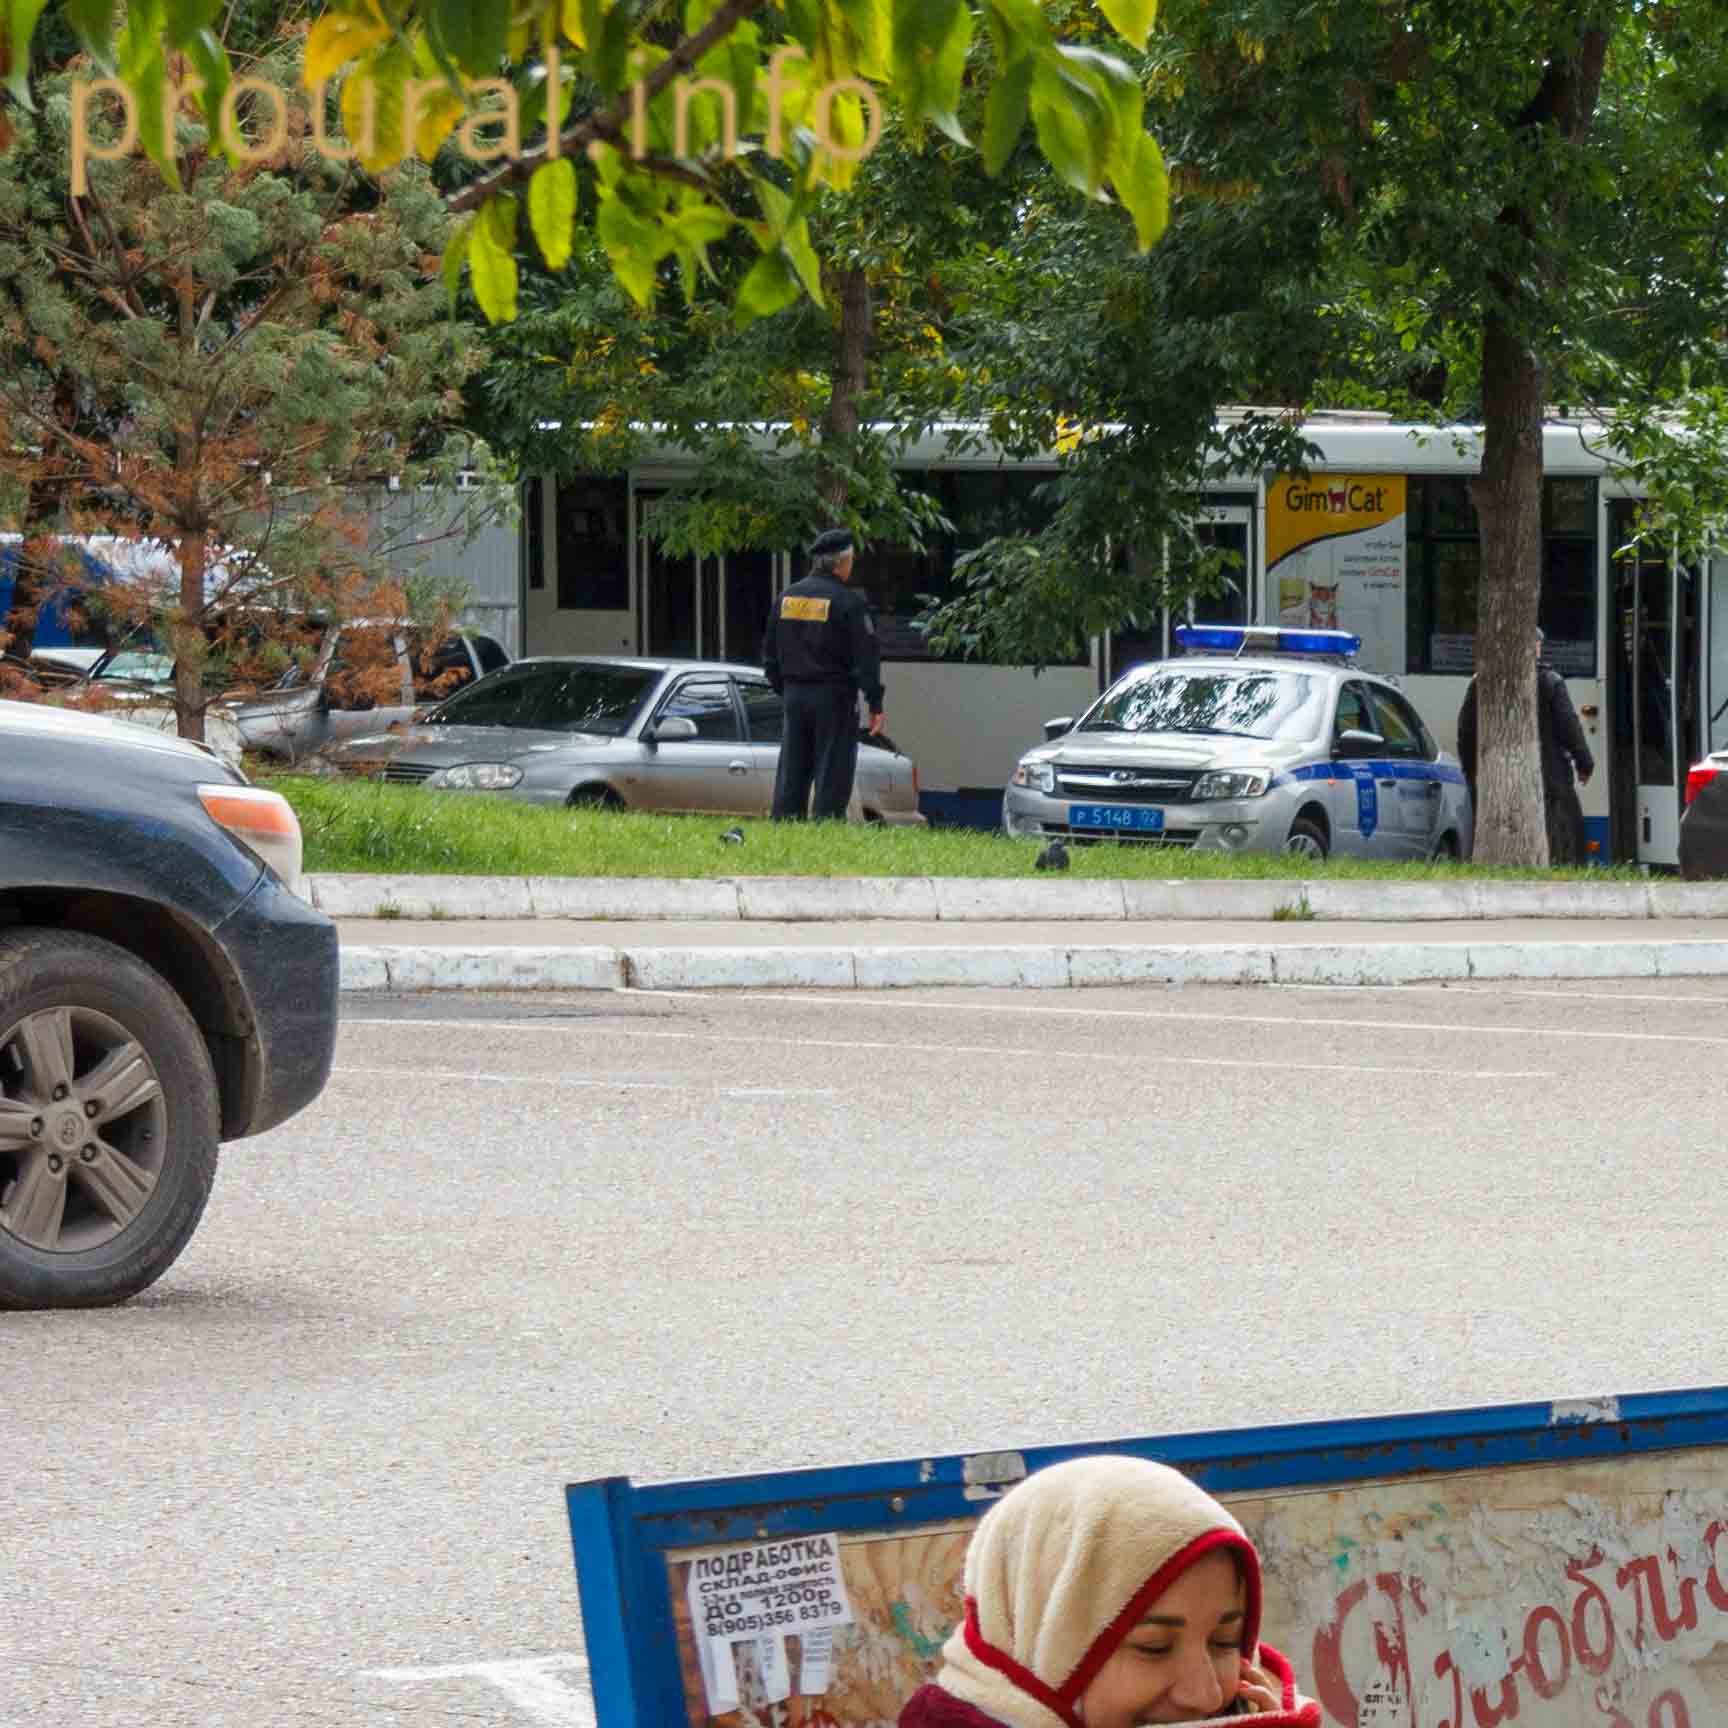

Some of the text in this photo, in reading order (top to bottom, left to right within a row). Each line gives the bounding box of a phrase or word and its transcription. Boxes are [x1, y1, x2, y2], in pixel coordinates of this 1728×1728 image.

[696, 1538, 835, 1579] ПОДРАБОТКА
[699, 1561, 832, 1593] СКЛАД-ОФИС
[705, 1588, 832, 1623] ДО 1200р
[706, 1609, 796, 1638] 8(905)356
